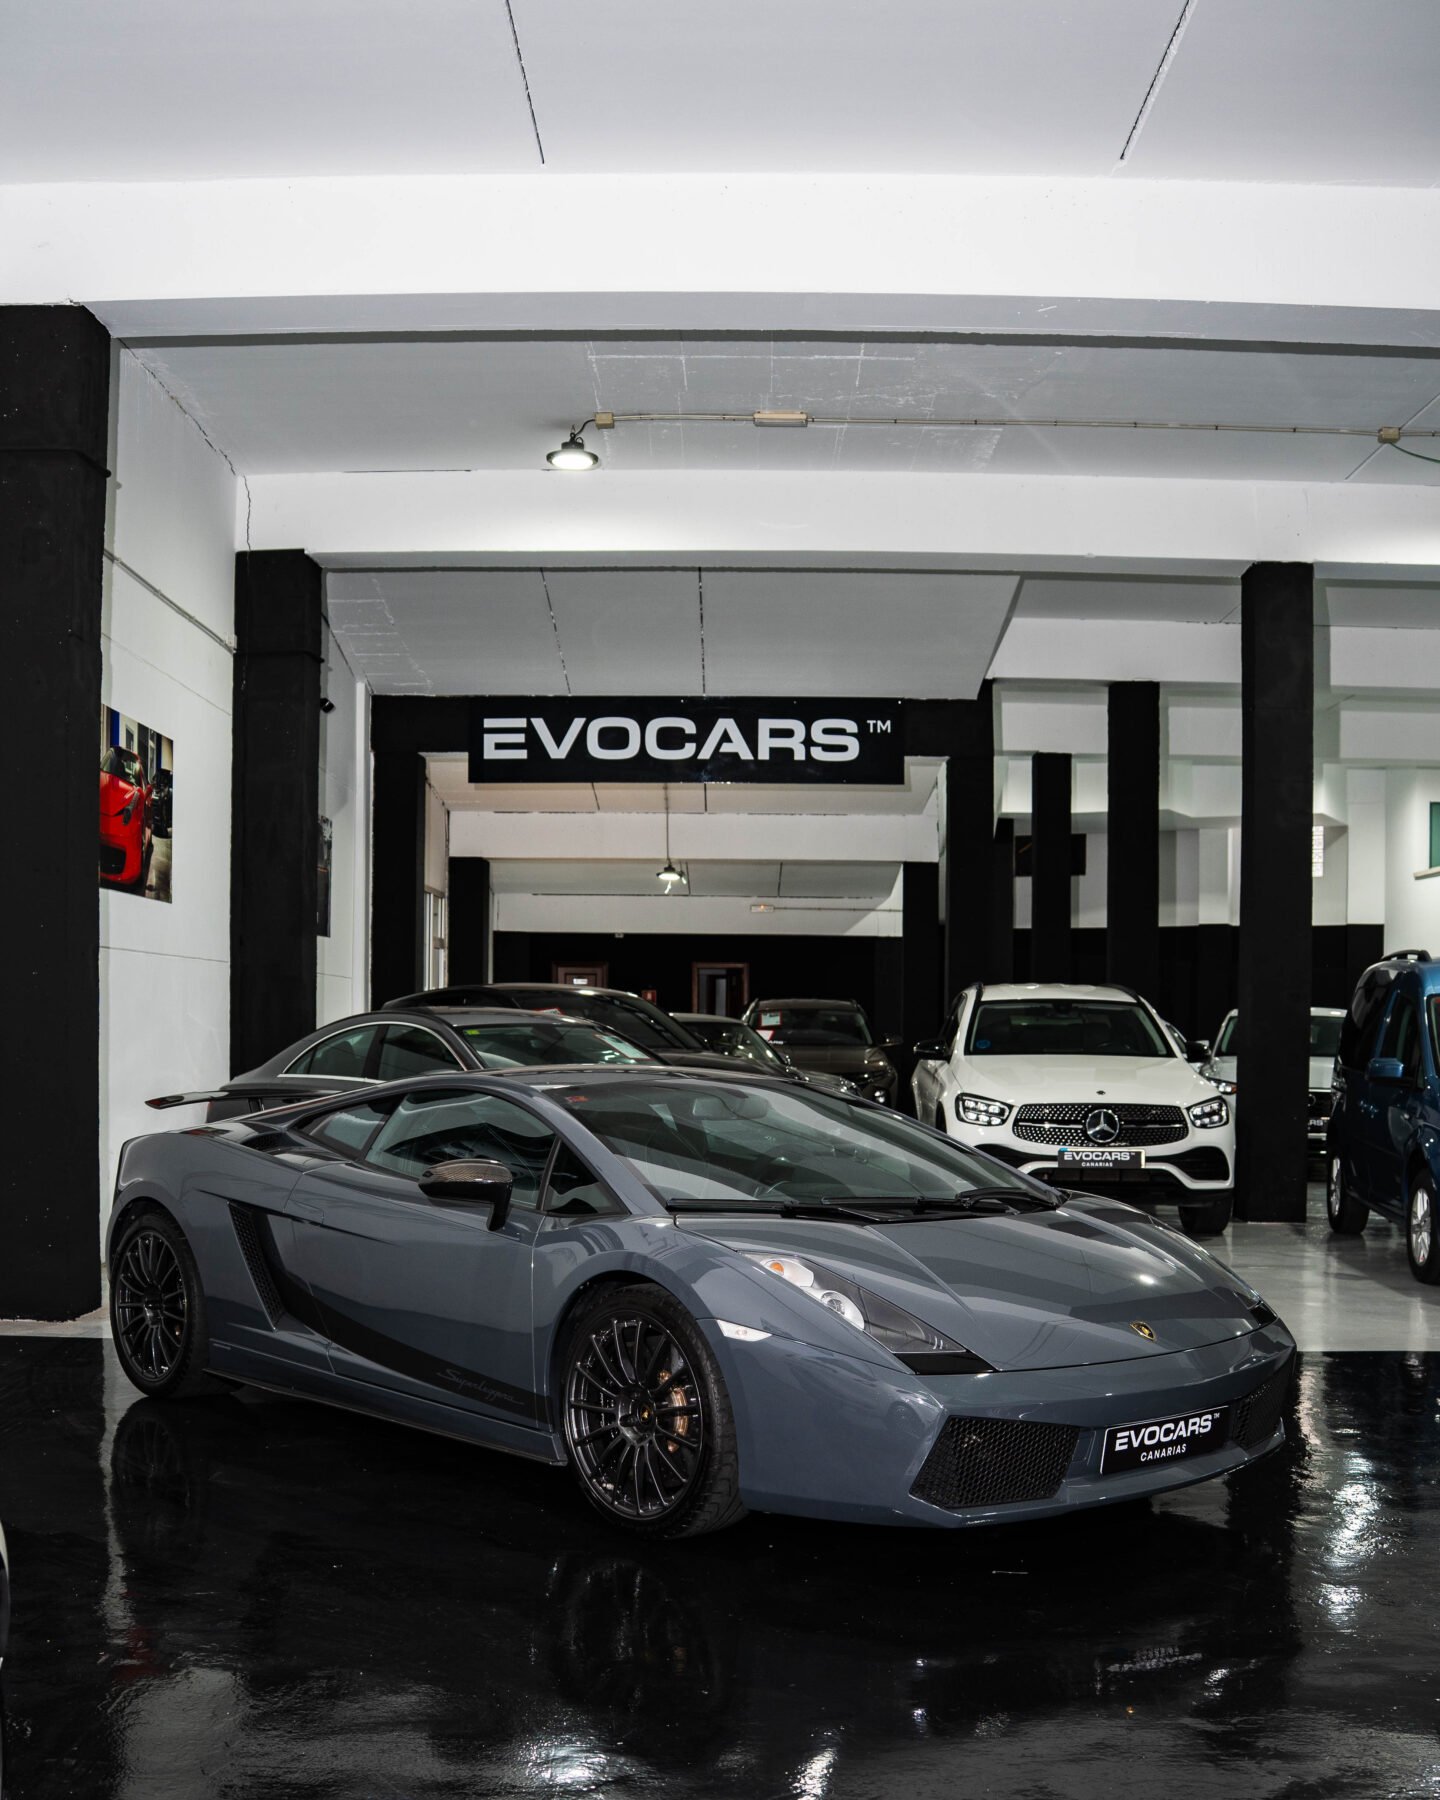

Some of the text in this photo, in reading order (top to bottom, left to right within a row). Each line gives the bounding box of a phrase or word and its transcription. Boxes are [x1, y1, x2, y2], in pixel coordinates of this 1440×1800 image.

[483, 716, 860, 762] EVOCARS
[1064, 1151, 1130, 1161] EVOCARS
[1114, 1414, 1212, 1452] EVOCARS
[1140, 1443, 1187, 1462] CANARIAS
